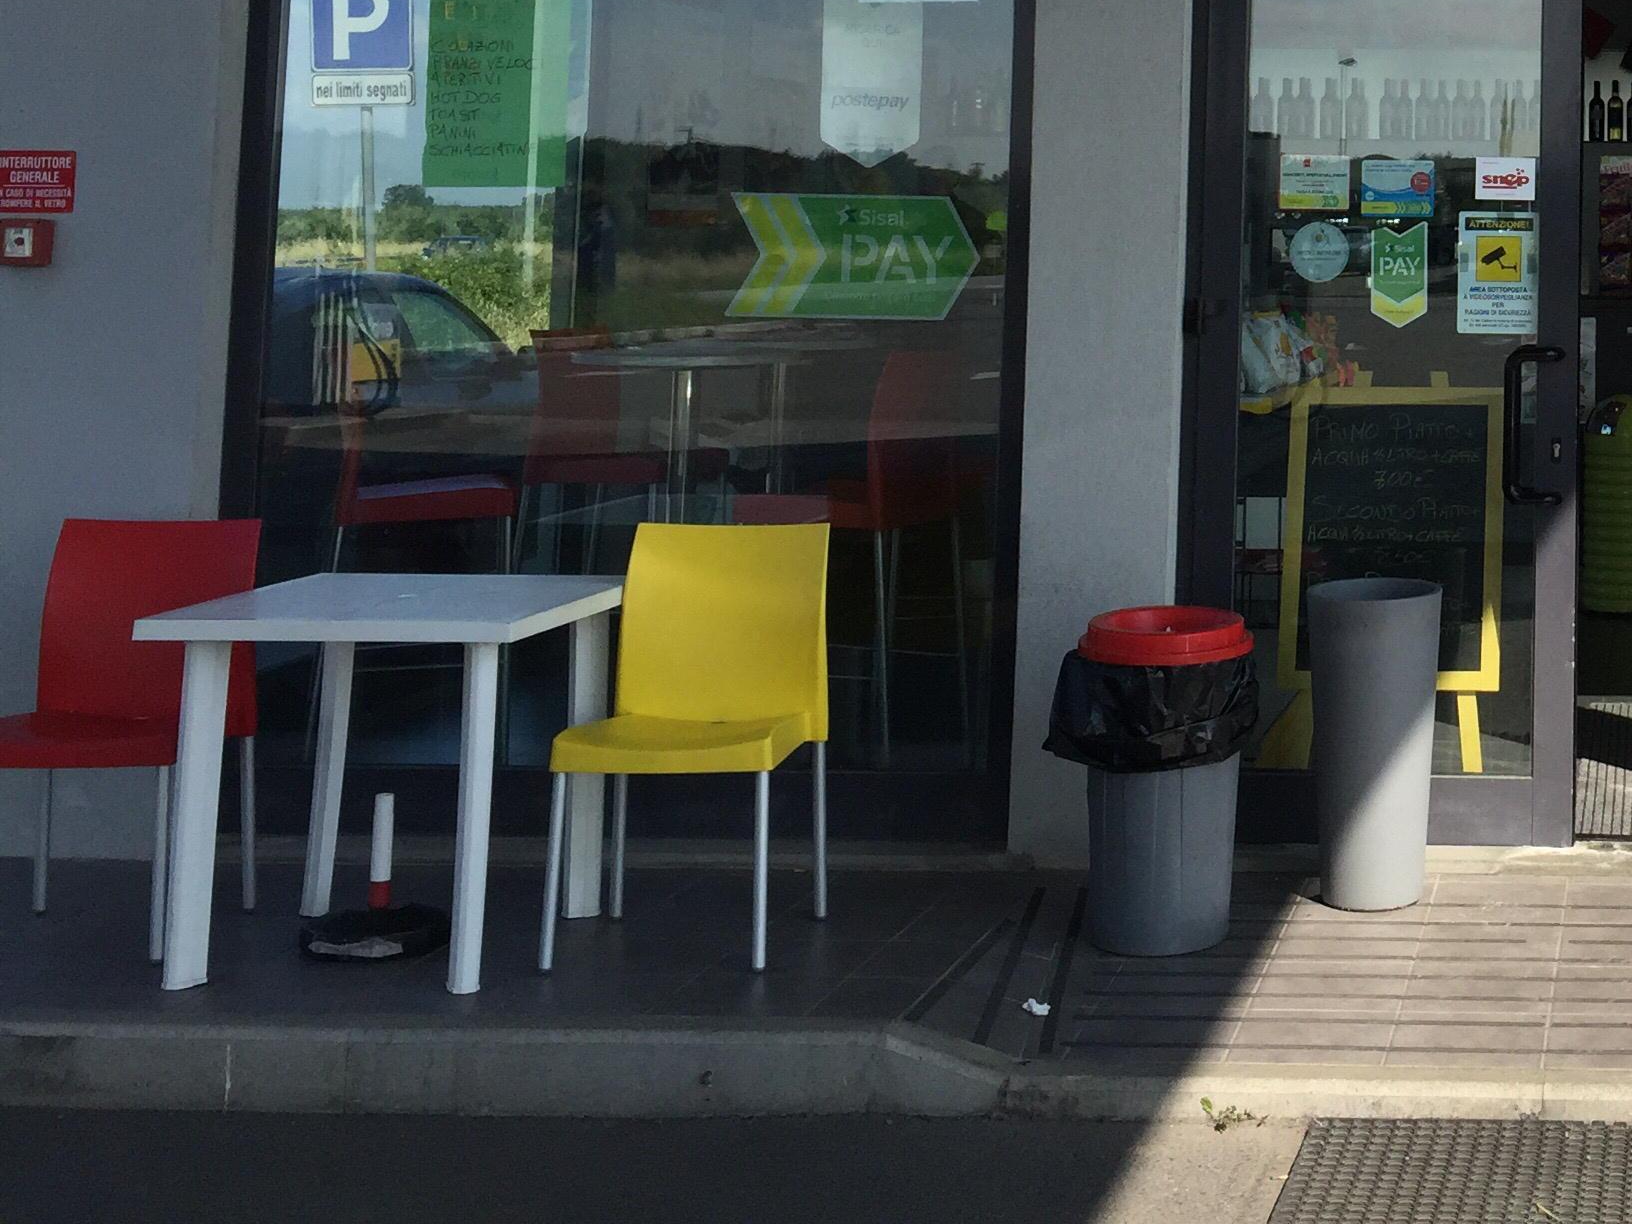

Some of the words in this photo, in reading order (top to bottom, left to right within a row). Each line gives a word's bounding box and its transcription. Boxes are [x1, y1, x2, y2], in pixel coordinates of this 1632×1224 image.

[316, 84, 333, 98] nei
[336, 80, 363, 98] limiti
[366, 80, 408, 101] segnati
[462, 90, 502, 104] DOG
[831, 91, 911, 112] postepay
[429, 107, 481, 122] TOAST
[9, 171, 60, 183] GENERALE
[859, 209, 905, 227] Sisal
[1468, 219, 1530, 229] ATTENZIONE!
[840, 233, 955, 286] PAY
[1379, 256, 1421, 277] PAY
